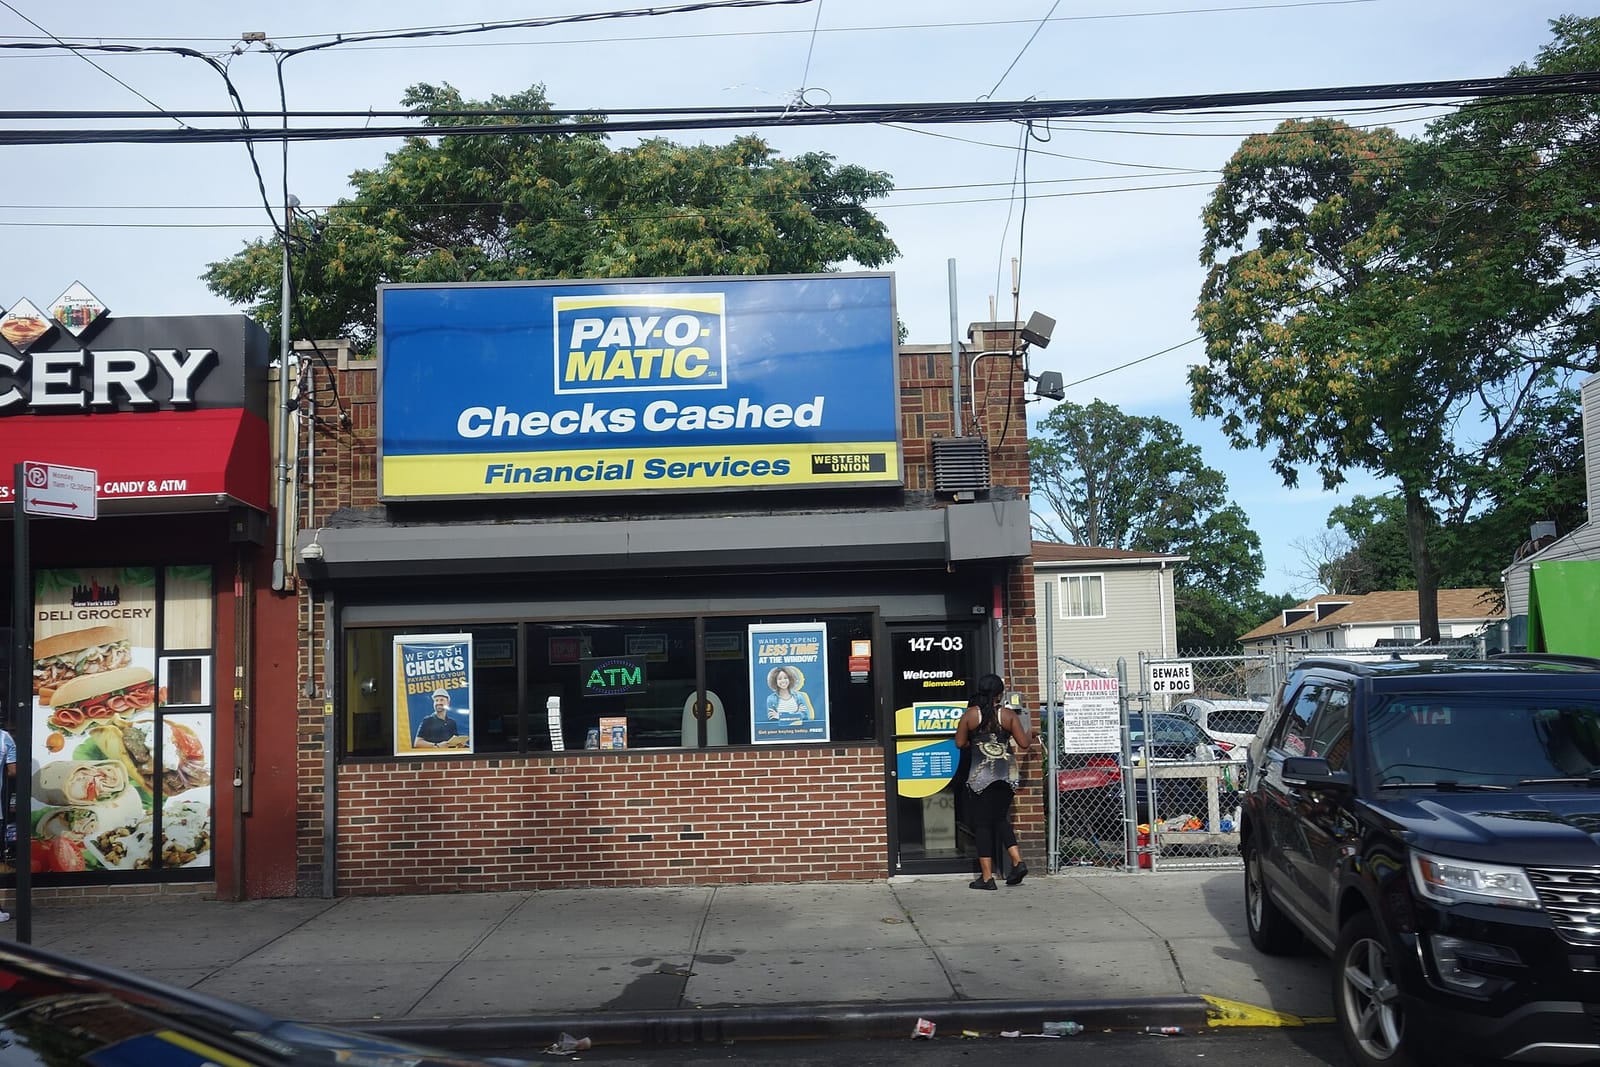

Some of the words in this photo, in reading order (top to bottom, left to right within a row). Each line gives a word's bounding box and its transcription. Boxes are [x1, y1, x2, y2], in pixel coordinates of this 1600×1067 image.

[564, 347, 710, 382] MATIC
[456, 403, 636, 438] Checks
[642, 396, 825, 431] Cashed
[814, 455, 869, 464] WESTERN
[485, 460, 634, 484] Financial
[644, 457, 790, 480] Services
[832, 464, 870, 472] UNION
[52, 472, 74, 481] Monday
[104, 481, 144, 494] CANDY
[147, 481, 157, 492] &
[159, 480, 187, 492] ATM
[38, 610, 73, 621] DELI
[77, 608, 152, 620] GROCERY
[758, 643, 789, 656] LESS
[790, 642, 819, 655] TIME
[908, 637, 963, 652] 147-03
[405, 652, 423, 661] WE
[427, 648, 462, 660] CASH
[758, 656, 769, 664] AT
[769, 656, 783, 664] THE
[783, 655, 818, 663] WINDOW?
[405, 656, 465, 677] CHECKS
[1152, 667, 1190, 678] BEWARE
[407, 675, 435, 683] PAYABLE
[586, 667, 642, 687] ATM
[903, 670, 953, 680] Welcome
[408, 677, 467, 695] BUSINESS
[923, 680, 965, 688] Bienvenido
[1064, 679, 1118, 691] WARNING
[1153, 681, 1166, 691] OF
[1169, 680, 1190, 690] DOG
